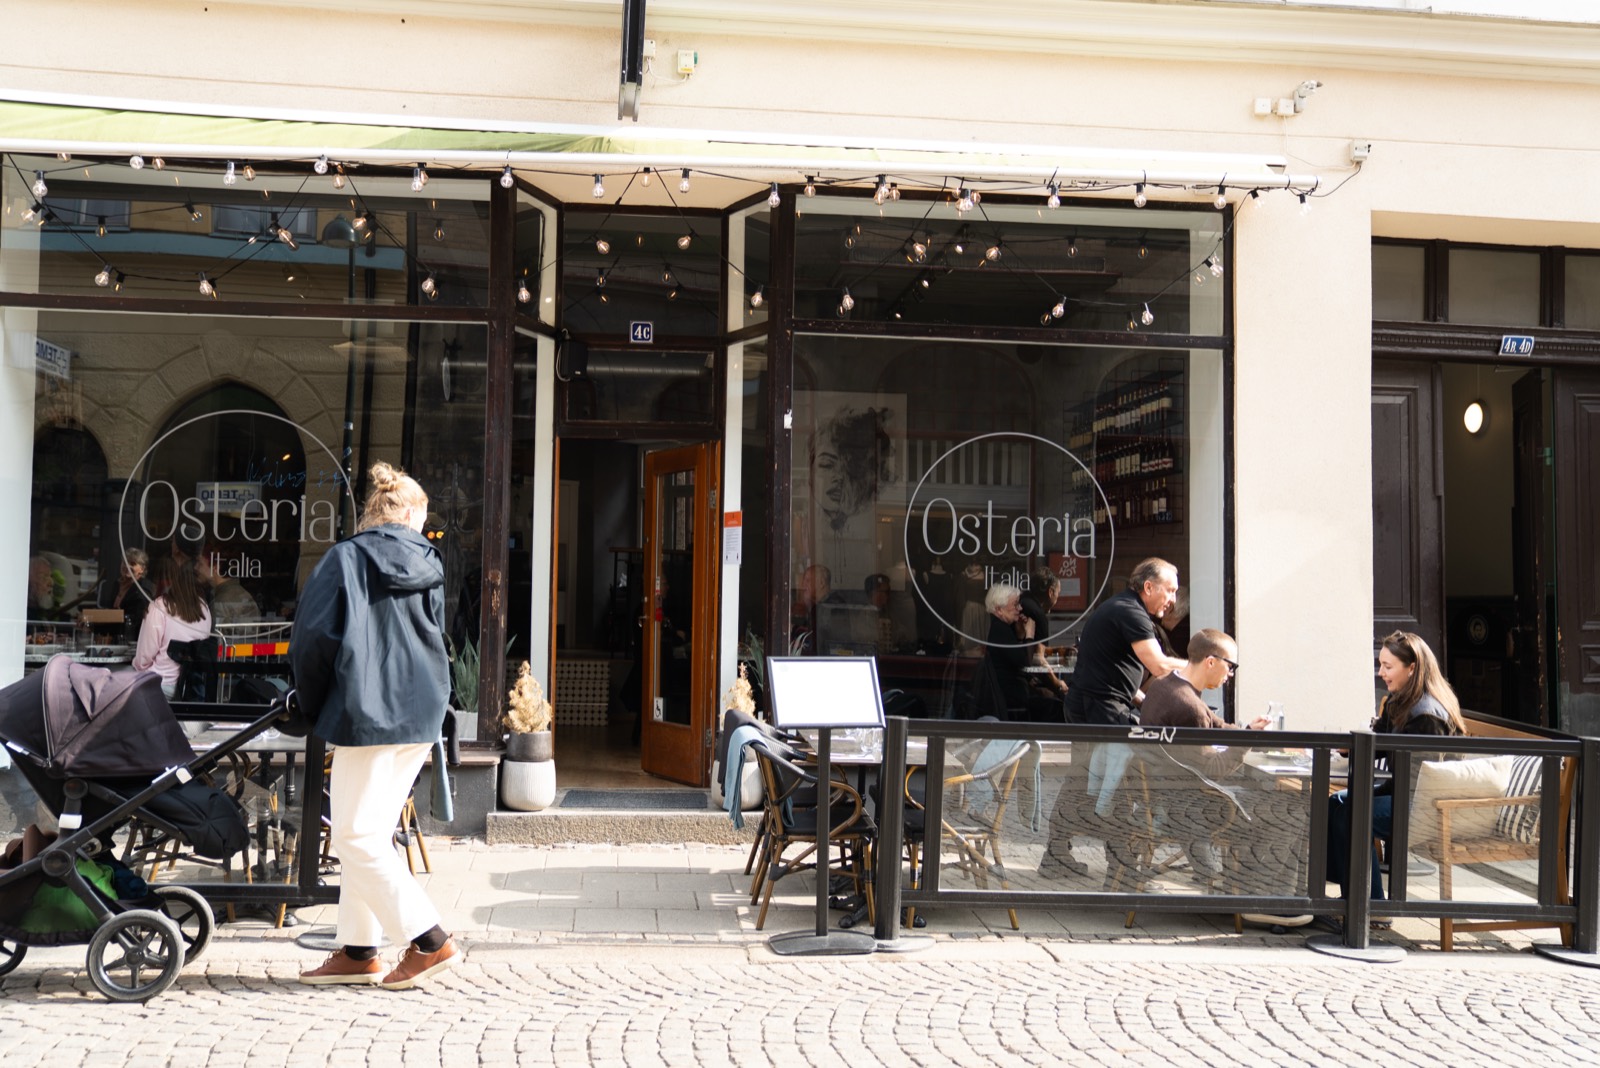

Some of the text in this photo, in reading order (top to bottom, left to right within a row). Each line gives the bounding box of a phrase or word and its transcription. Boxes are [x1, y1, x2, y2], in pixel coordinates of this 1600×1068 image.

[634, 325, 650, 339] 4C
[1519, 338, 1531, 353] 4D
[140, 480, 337, 543] Osteria
[922, 498, 1096, 559] Osteria
[210, 551, 262, 578] Italia
[984, 565, 1031, 591] Italia
